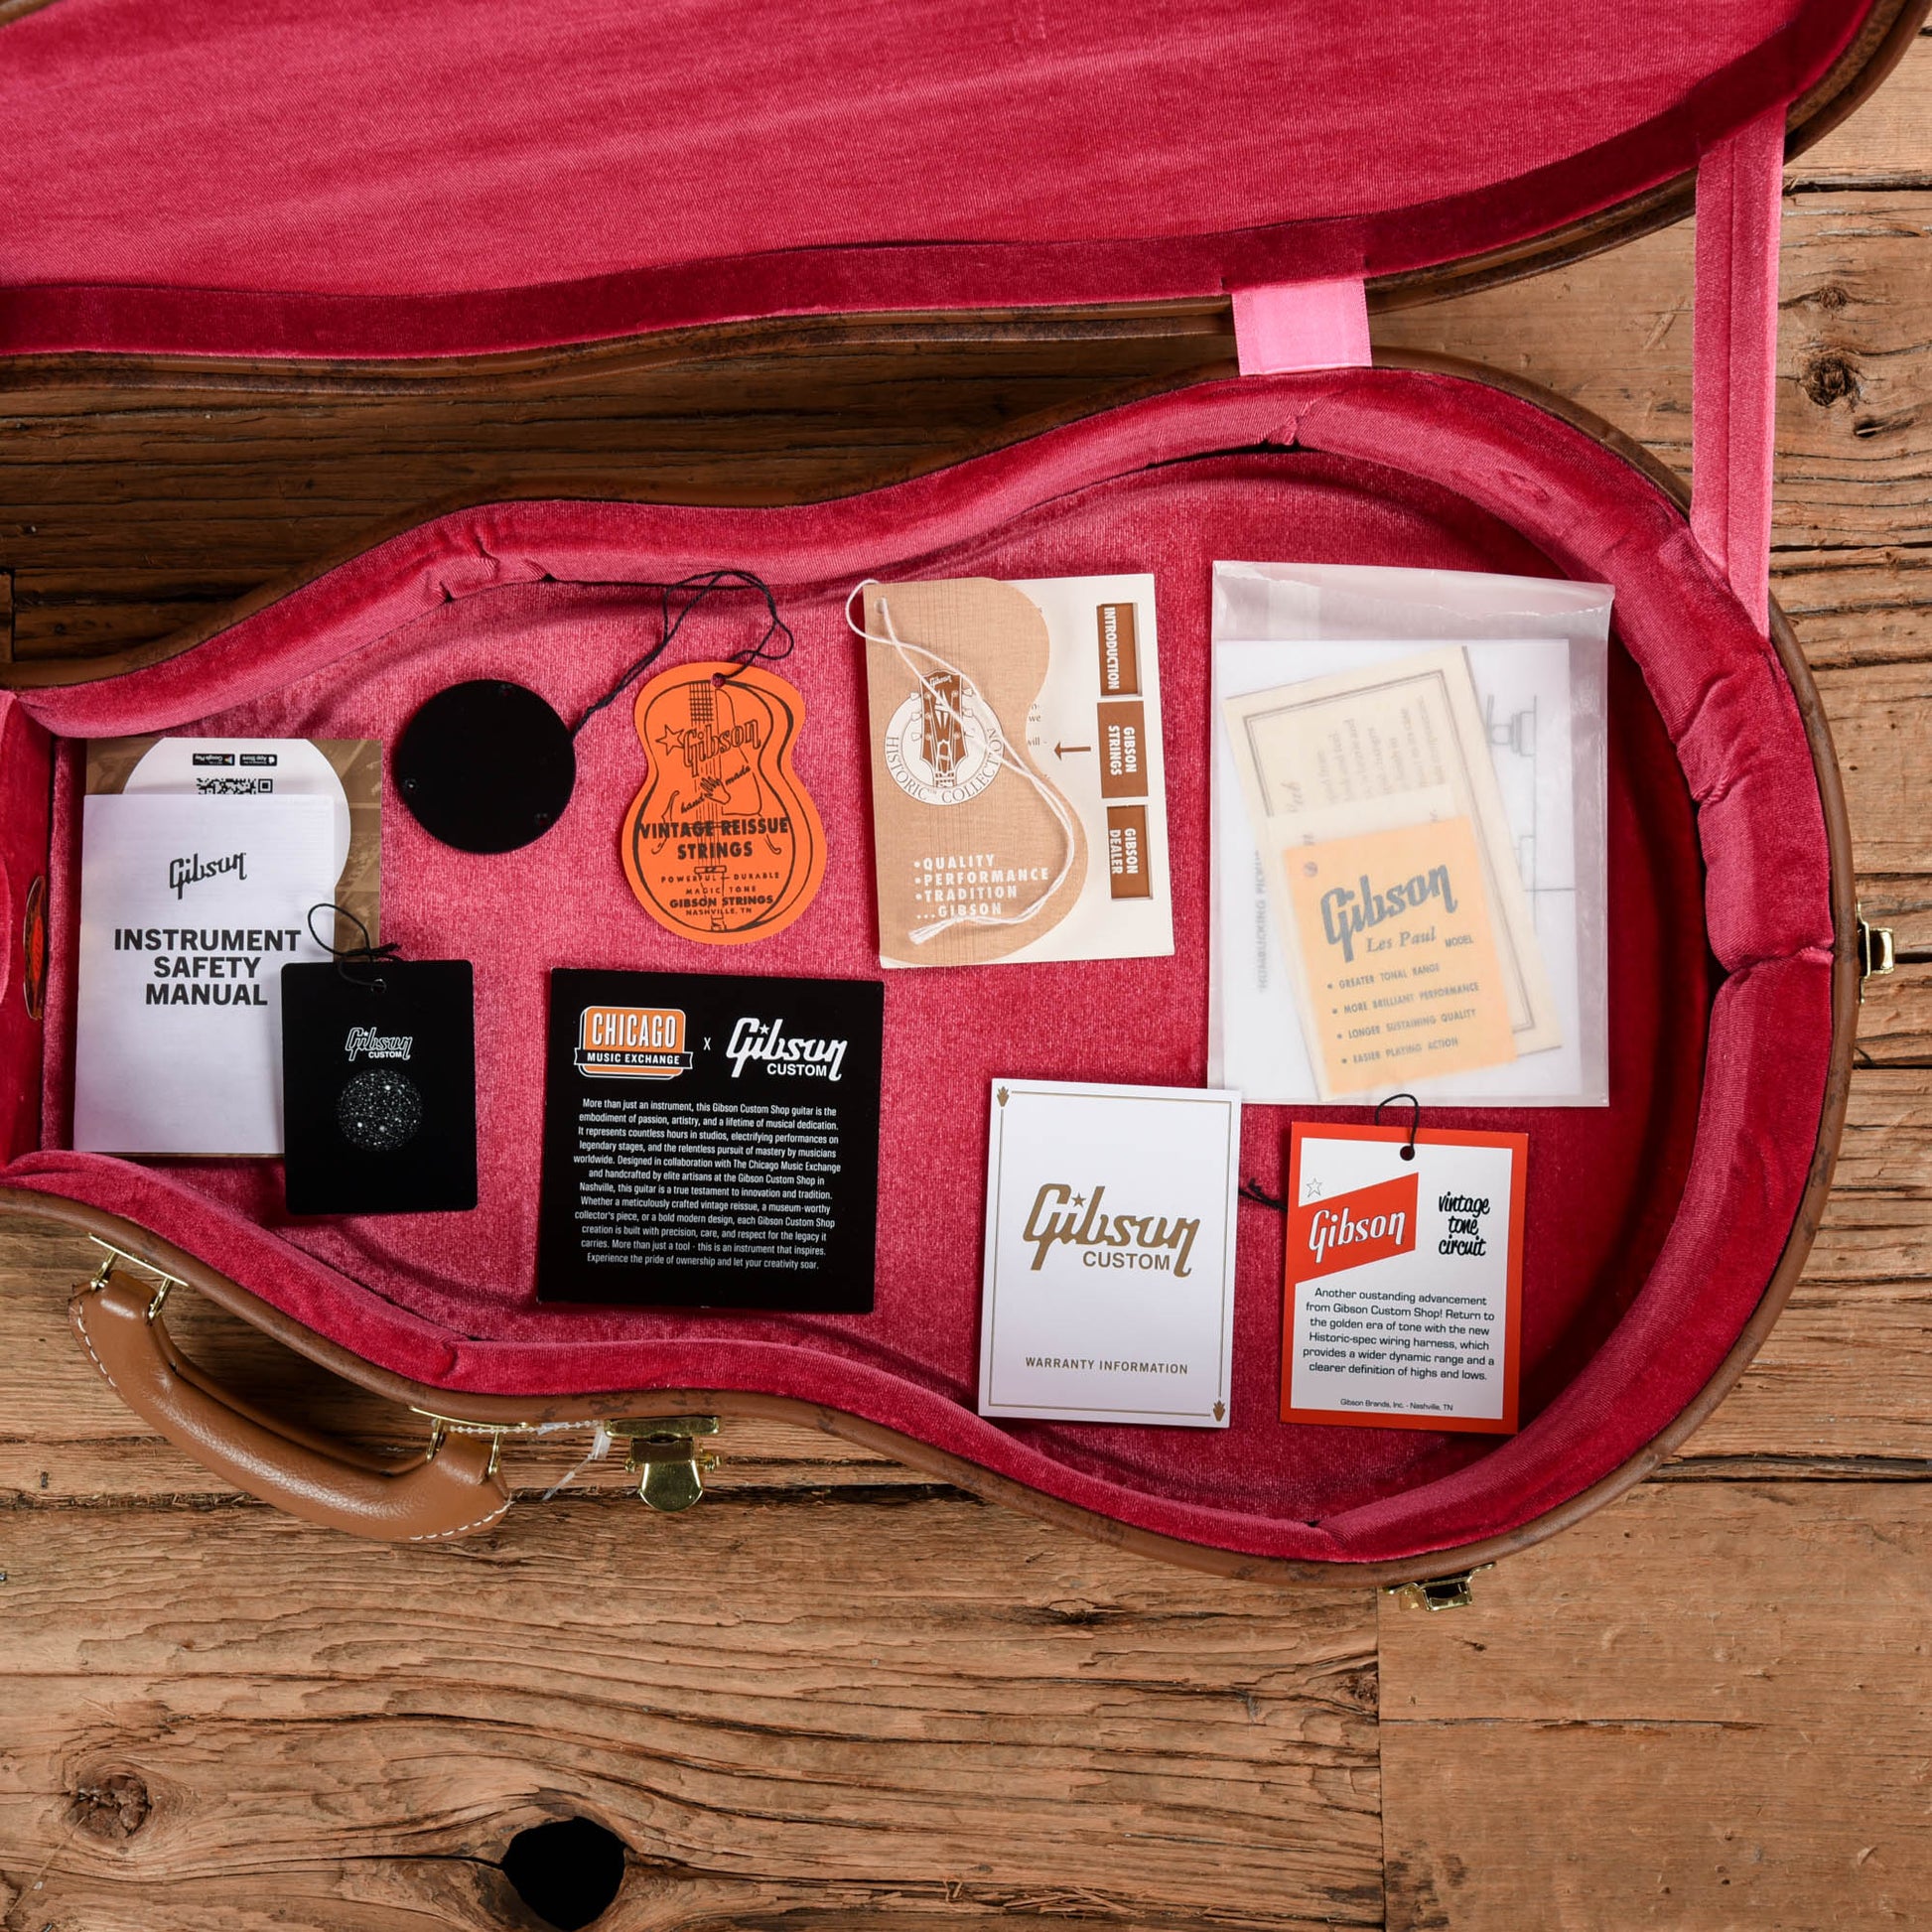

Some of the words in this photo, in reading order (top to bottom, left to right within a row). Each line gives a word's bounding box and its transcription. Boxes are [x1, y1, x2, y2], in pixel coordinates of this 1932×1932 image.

[1104, 608, 1118, 690] INTRODUCTION
[683, 719, 760, 777] Gibson
[1108, 726, 1121, 775] STRINGS
[1123, 727, 1136, 773] GIBSON
[887, 737, 926, 800] HISTORIC
[942, 727, 1002, 803] COLLECTON
[640, 820, 715, 838] VINTAGE
[721, 816, 788, 835] REISSUE
[677, 842, 753, 860] STRINGS
[923, 854, 995, 868] QUALITY
[1109, 829, 1123, 875] DEALER
[1125, 828, 1136, 875] GIBSON
[169, 853, 247, 899] Gibson
[924, 868, 1048, 887] PERFORMANCE
[669, 897, 717, 908] GIBSON
[722, 896, 773, 905] STRINGS
[925, 886, 1017, 902] TRADITION
[1320, 865, 1457, 963] Gibson
[114, 929, 301, 951] INSTRUMENT
[1367, 936, 1393, 953] Les
[1399, 927, 1438, 948] Paul
[1445, 935, 1474, 947] MODEL
[154, 956, 261, 978] SAFETY
[1339, 973, 1374, 990] GREATER
[1381, 969, 1408, 982] TONAL
[1412, 963, 1440, 976] RANGE
[145, 984, 268, 1006] MANUAL
[1343, 1001, 1368, 1014] MORE
[592, 1013, 677, 1048] CHICAGO
[1348, 1026, 1381, 1038] LONGER
[1441, 1009, 1476, 1023] QUALITY
[345, 1027, 412, 1061] Gibson
[726, 1018, 848, 1081] Gibson
[1353, 1051, 1381, 1063] EASIER
[1428, 1037, 1458, 1049] ACTION
[588, 1052, 621, 1063] MUSIC
[625, 1053, 680, 1065] EXCHANGE
[767, 1063, 827, 1076] CUSTOM
[582, 1098, 602, 1108] More
[604, 1099, 621, 1109] than
[622, 1100, 637, 1111] just
[696, 1102, 710, 1112] this
[712, 1103, 738, 1113] Gibson
[740, 1103, 768, 1114] Custom
[770, 1105, 789, 1117] Shop
[791, 1106, 813, 1117] guitar
[815, 1106, 822, 1116] is
[823, 1107, 836, 1116] the
[579, 1112, 626, 1123] embodiment
[627, 1114, 636, 1123] of
[702, 1117, 717, 1126] and
[725, 1117, 755, 1128] lifetime
[756, 1118, 763, 1128] of
[765, 1119, 795, 1129] musical
[578, 1126, 584, 1136] It
[586, 1128, 626, 1138] represents
[627, 1129, 664, 1138] countless
[666, 1129, 688, 1139] hours
[690, 1130, 697, 1139] in
[731, 1132, 773, 1144] electrifying
[774, 1133, 827, 1144] performances
[579, 1140, 617, 1153] legendary
[647, 1143, 662, 1152] and
[663, 1143, 676, 1153] the
[678, 1144, 715, 1154] relentless
[717, 1146, 744, 1156] pursuit
[745, 1146, 754, 1156] of
[755, 1147, 785, 1159] mastery
[786, 1147, 796, 1159] by
[797, 1148, 836, 1158] musicians
[1439, 1191, 1490, 1217] vintage
[1023, 1183, 1200, 1278] Gibson
[1309, 1208, 1406, 1263] Gibson
[1083, 1251, 1171, 1270] CUSTOM
[1314, 1288, 1356, 1299] Another
[1358, 1292, 1416, 1305] oustanding
[1418, 1294, 1487, 1306] advancement
[1306, 1302, 1330, 1312] from
[1332, 1303, 1368, 1314] Gibson
[1370, 1305, 1412, 1316] Custom
[1413, 1307, 1443, 1320] Shop!
[1445, 1309, 1481, 1320] Return
[1483, 1312, 1495, 1321] to
[1310, 1317, 1326, 1327] the
[1329, 1318, 1363, 1330] golden
[1385, 1320, 1396, 1330] of
[1398, 1322, 1422, 1332] tone
[1424, 1323, 1446, 1333] with
[1449, 1324, 1465, 1334] the
[1468, 1327, 1489, 1336] new
[1309, 1331, 1377, 1346] Historic-spec
[1379, 1336, 1410, 1349] wiring
[1413, 1337, 1457, 1350] harness,
[1459, 1340, 1489, 1350] which
[1026, 1357, 1094, 1369] WARRANTY
[1099, 1360, 1188, 1374] INFORMATION
[1303, 1348, 1346, 1358] provides
[1357, 1349, 1387, 1360] wider
[1389, 1351, 1431, 1363] dynamic
[1434, 1355, 1463, 1366] range
[1466, 1356, 1485, 1365] and
[1309, 1362, 1346, 1373] clearer
[1347, 1364, 1395, 1375] definition
[1397, 1366, 1408, 1376] of
[1410, 1367, 1438, 1380] highs
[1440, 1369, 1459, 1379] and
[1461, 1369, 1487, 1381] lows.
